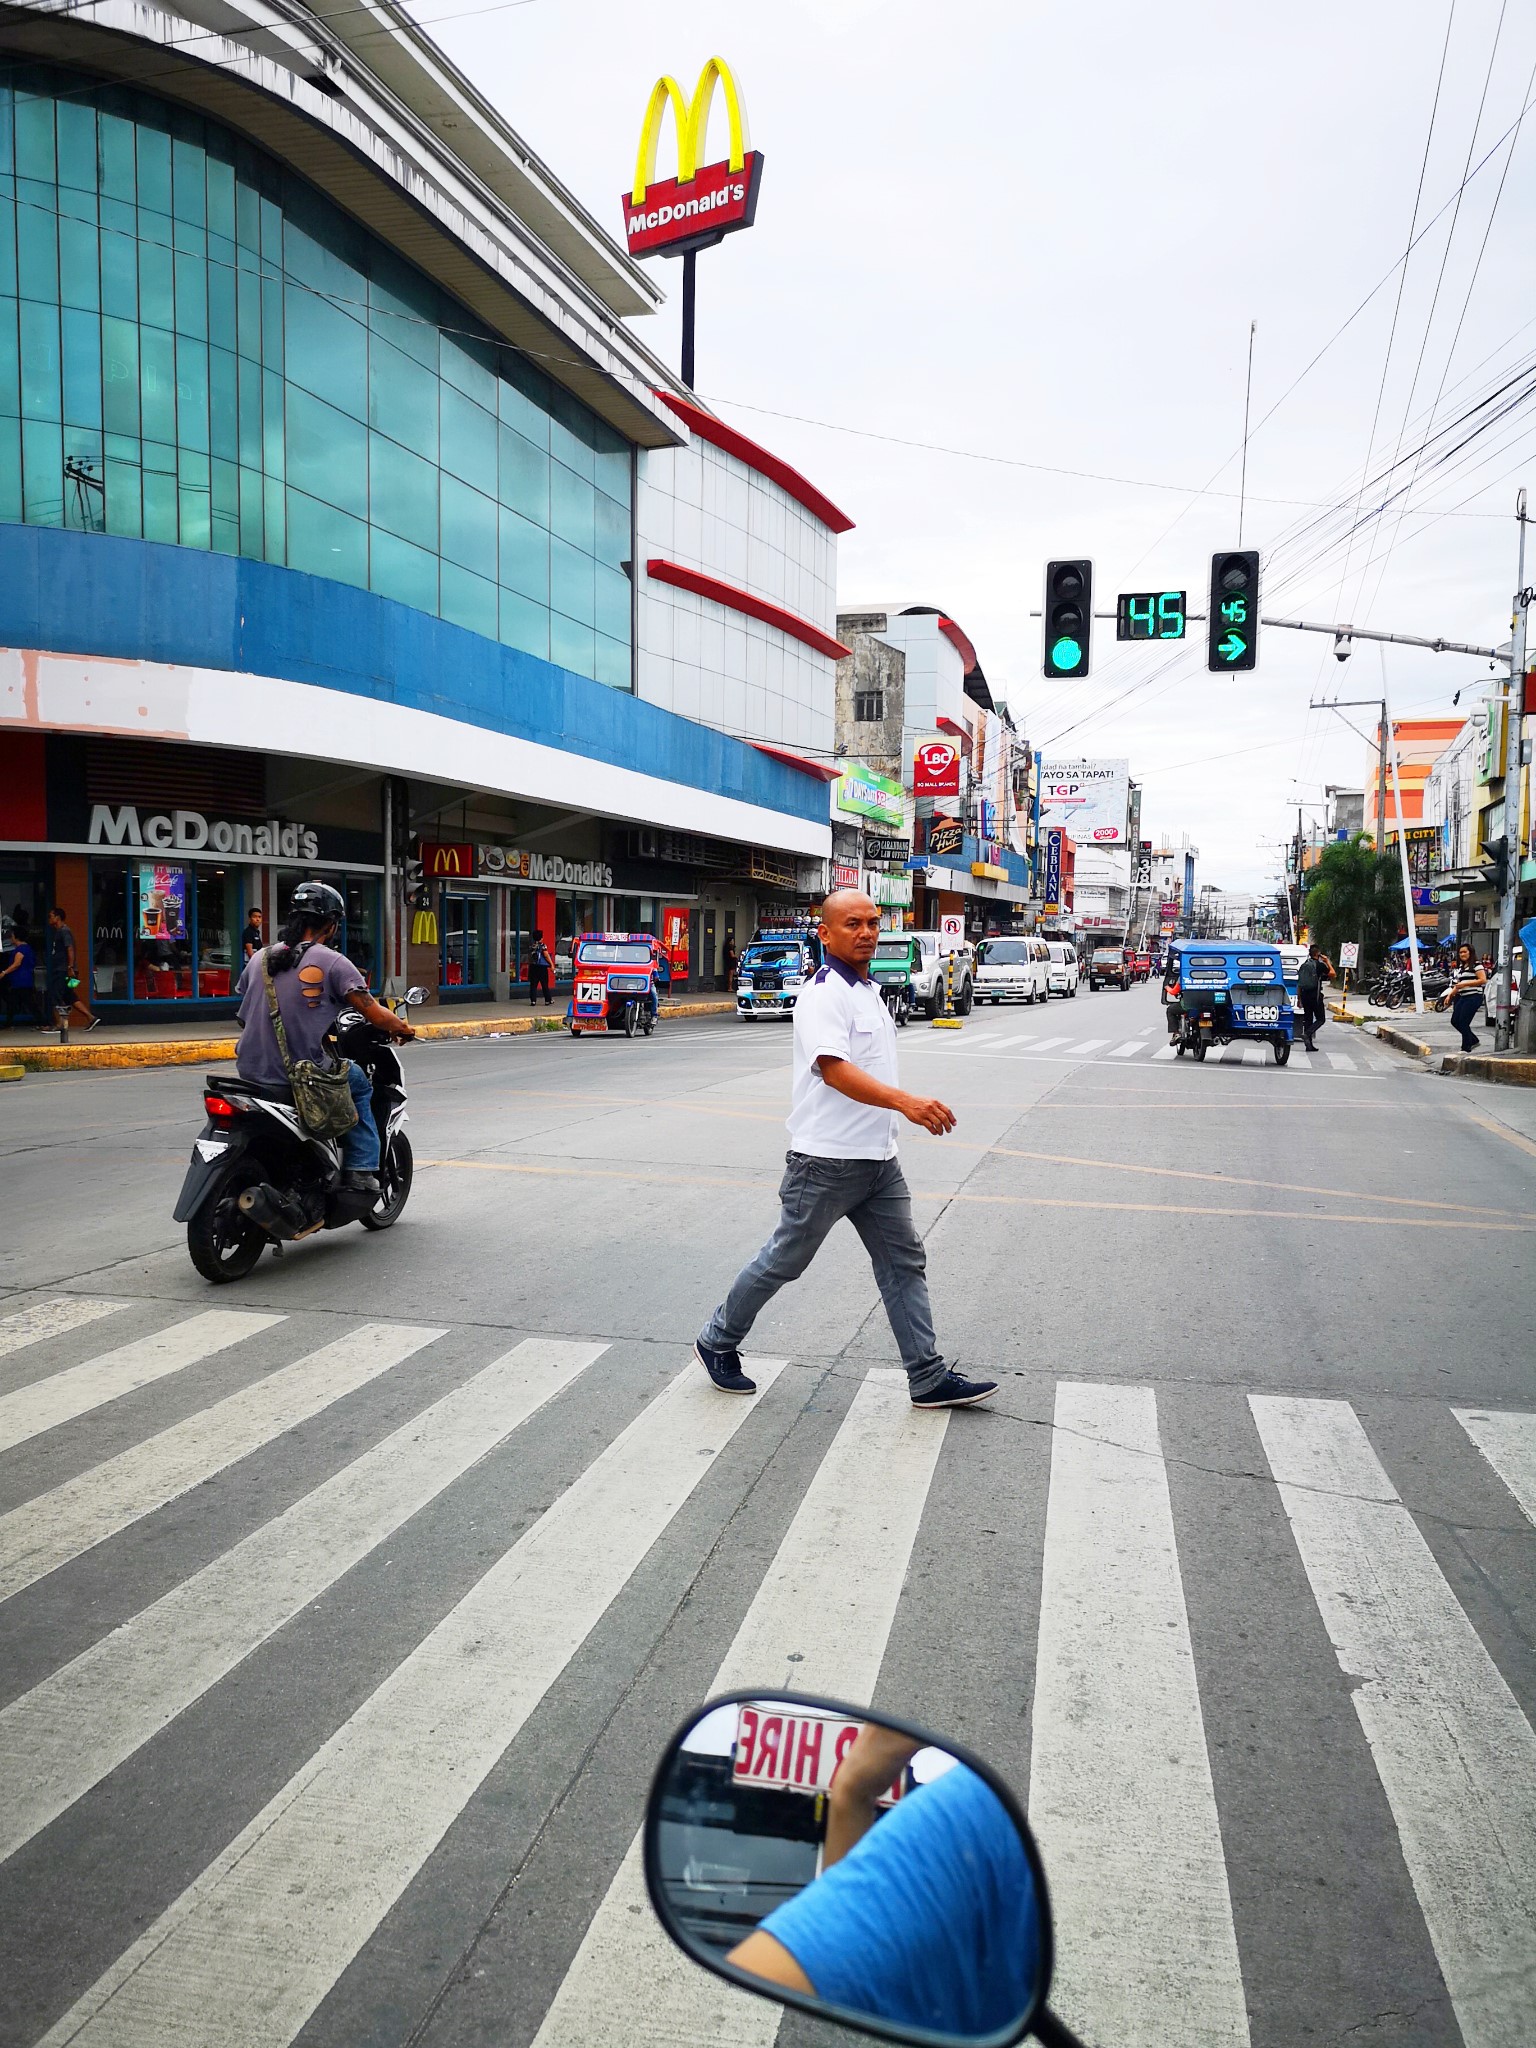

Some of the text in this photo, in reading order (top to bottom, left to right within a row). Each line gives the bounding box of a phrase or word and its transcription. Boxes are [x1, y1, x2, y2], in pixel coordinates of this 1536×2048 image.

[628, 184, 744, 235] McDonald's
[1129, 592, 1184, 639] 45
[1221, 600, 1247, 624] 45
[924, 752, 949, 765] LBC
[1066, 771, 1079, 779] SA
[1081, 770, 1114, 779] TAPAT!
[1047, 785, 1079, 796] TGP
[88, 804, 319, 859] McDonald's
[930, 827, 963, 847] Pizza
[1412, 829, 1436, 839] CITY
[936, 836, 961, 851] Hut
[165, 866, 184, 874] WITH
[529, 853, 613, 888] McDonald's
[1047, 832, 1061, 901] CEBUANA
[1161, 921, 1173, 929] RD
[576, 982, 607, 1001] 1781
[1247, 1005, 1278, 1020] 2580
